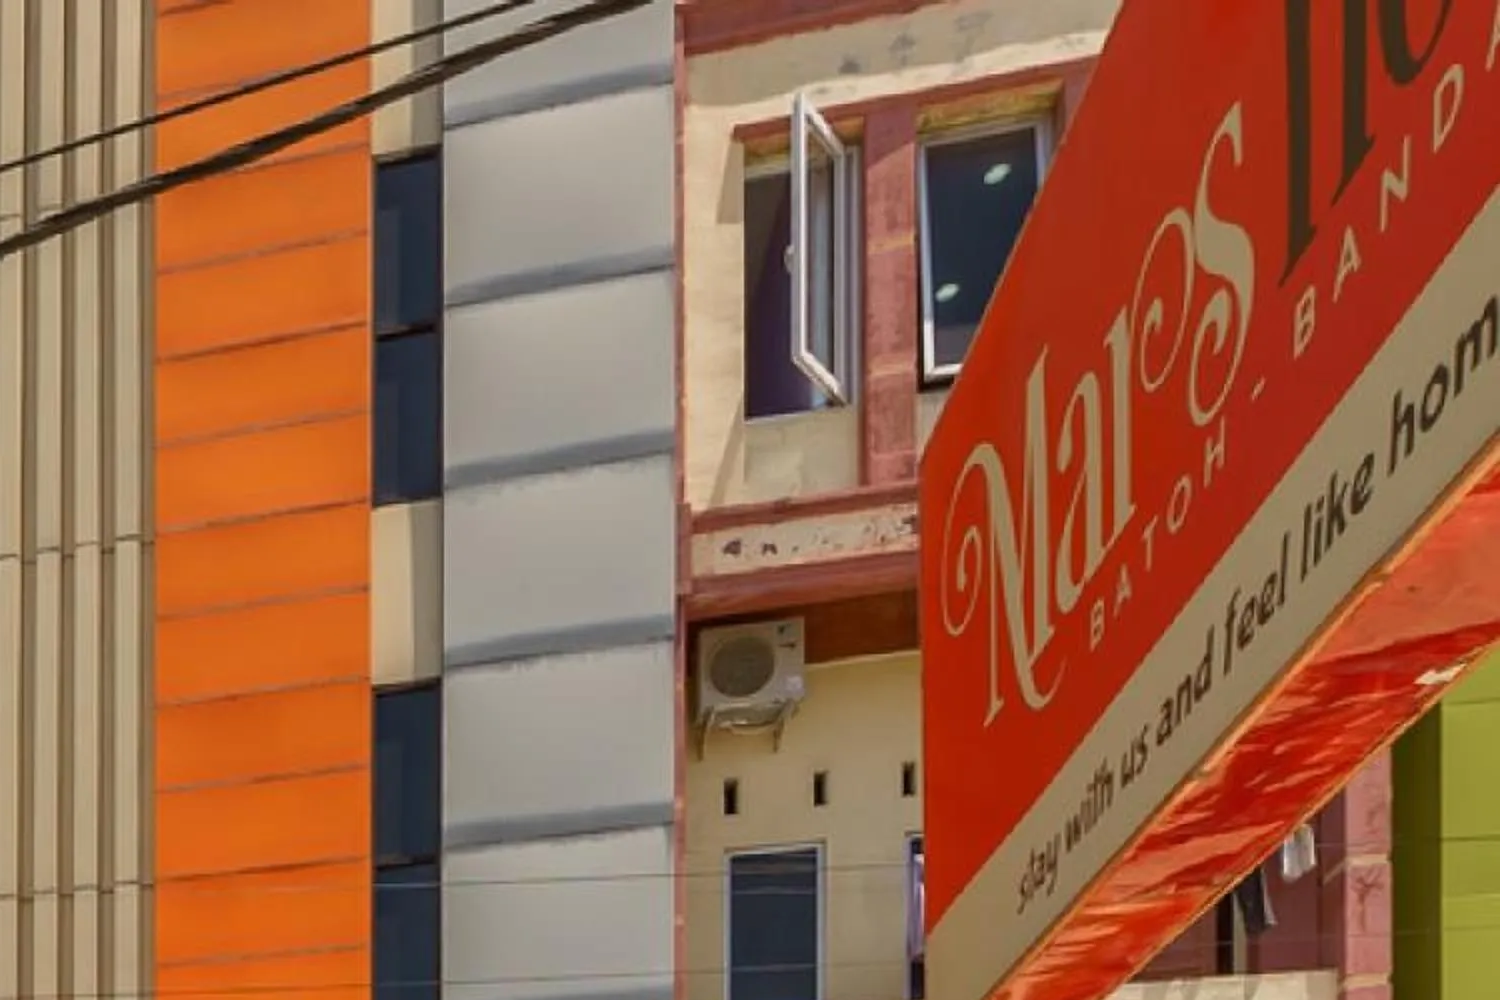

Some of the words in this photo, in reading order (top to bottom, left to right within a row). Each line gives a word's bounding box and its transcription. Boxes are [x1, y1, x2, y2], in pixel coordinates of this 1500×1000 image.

[1017, 834, 1060, 914] stay
[1065, 756, 1114, 851] with
[1121, 725, 1148, 788] us
[1156, 625, 1215, 746] and
[1223, 531, 1290, 675] feel
[1300, 452, 1375, 582] like
[1089, 417, 1225, 652] BATOH
